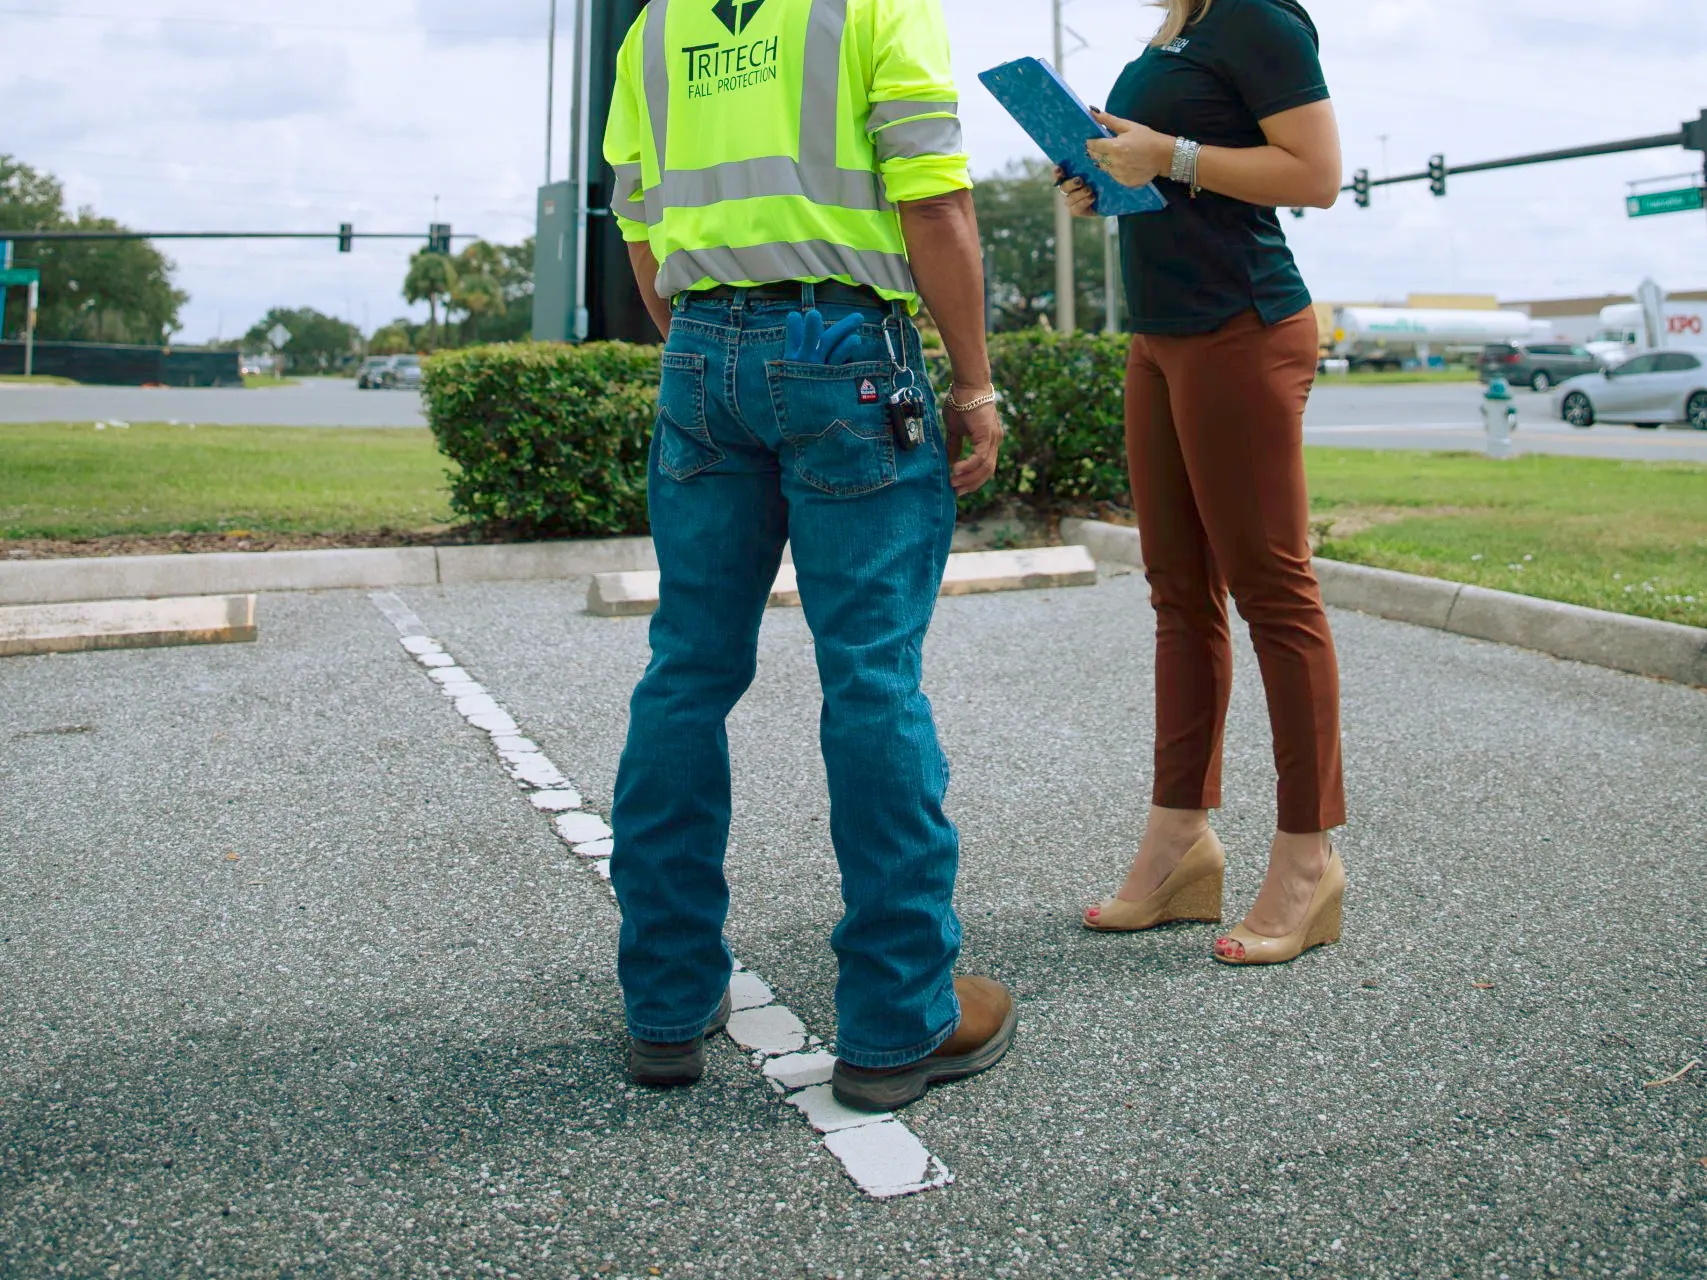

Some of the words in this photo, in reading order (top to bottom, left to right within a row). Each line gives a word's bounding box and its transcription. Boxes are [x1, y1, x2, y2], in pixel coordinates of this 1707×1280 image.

[682, 35, 778, 81] TRITECH
[688, 83, 713, 99] FALL
[717, 65, 777, 93] PROTECTION
